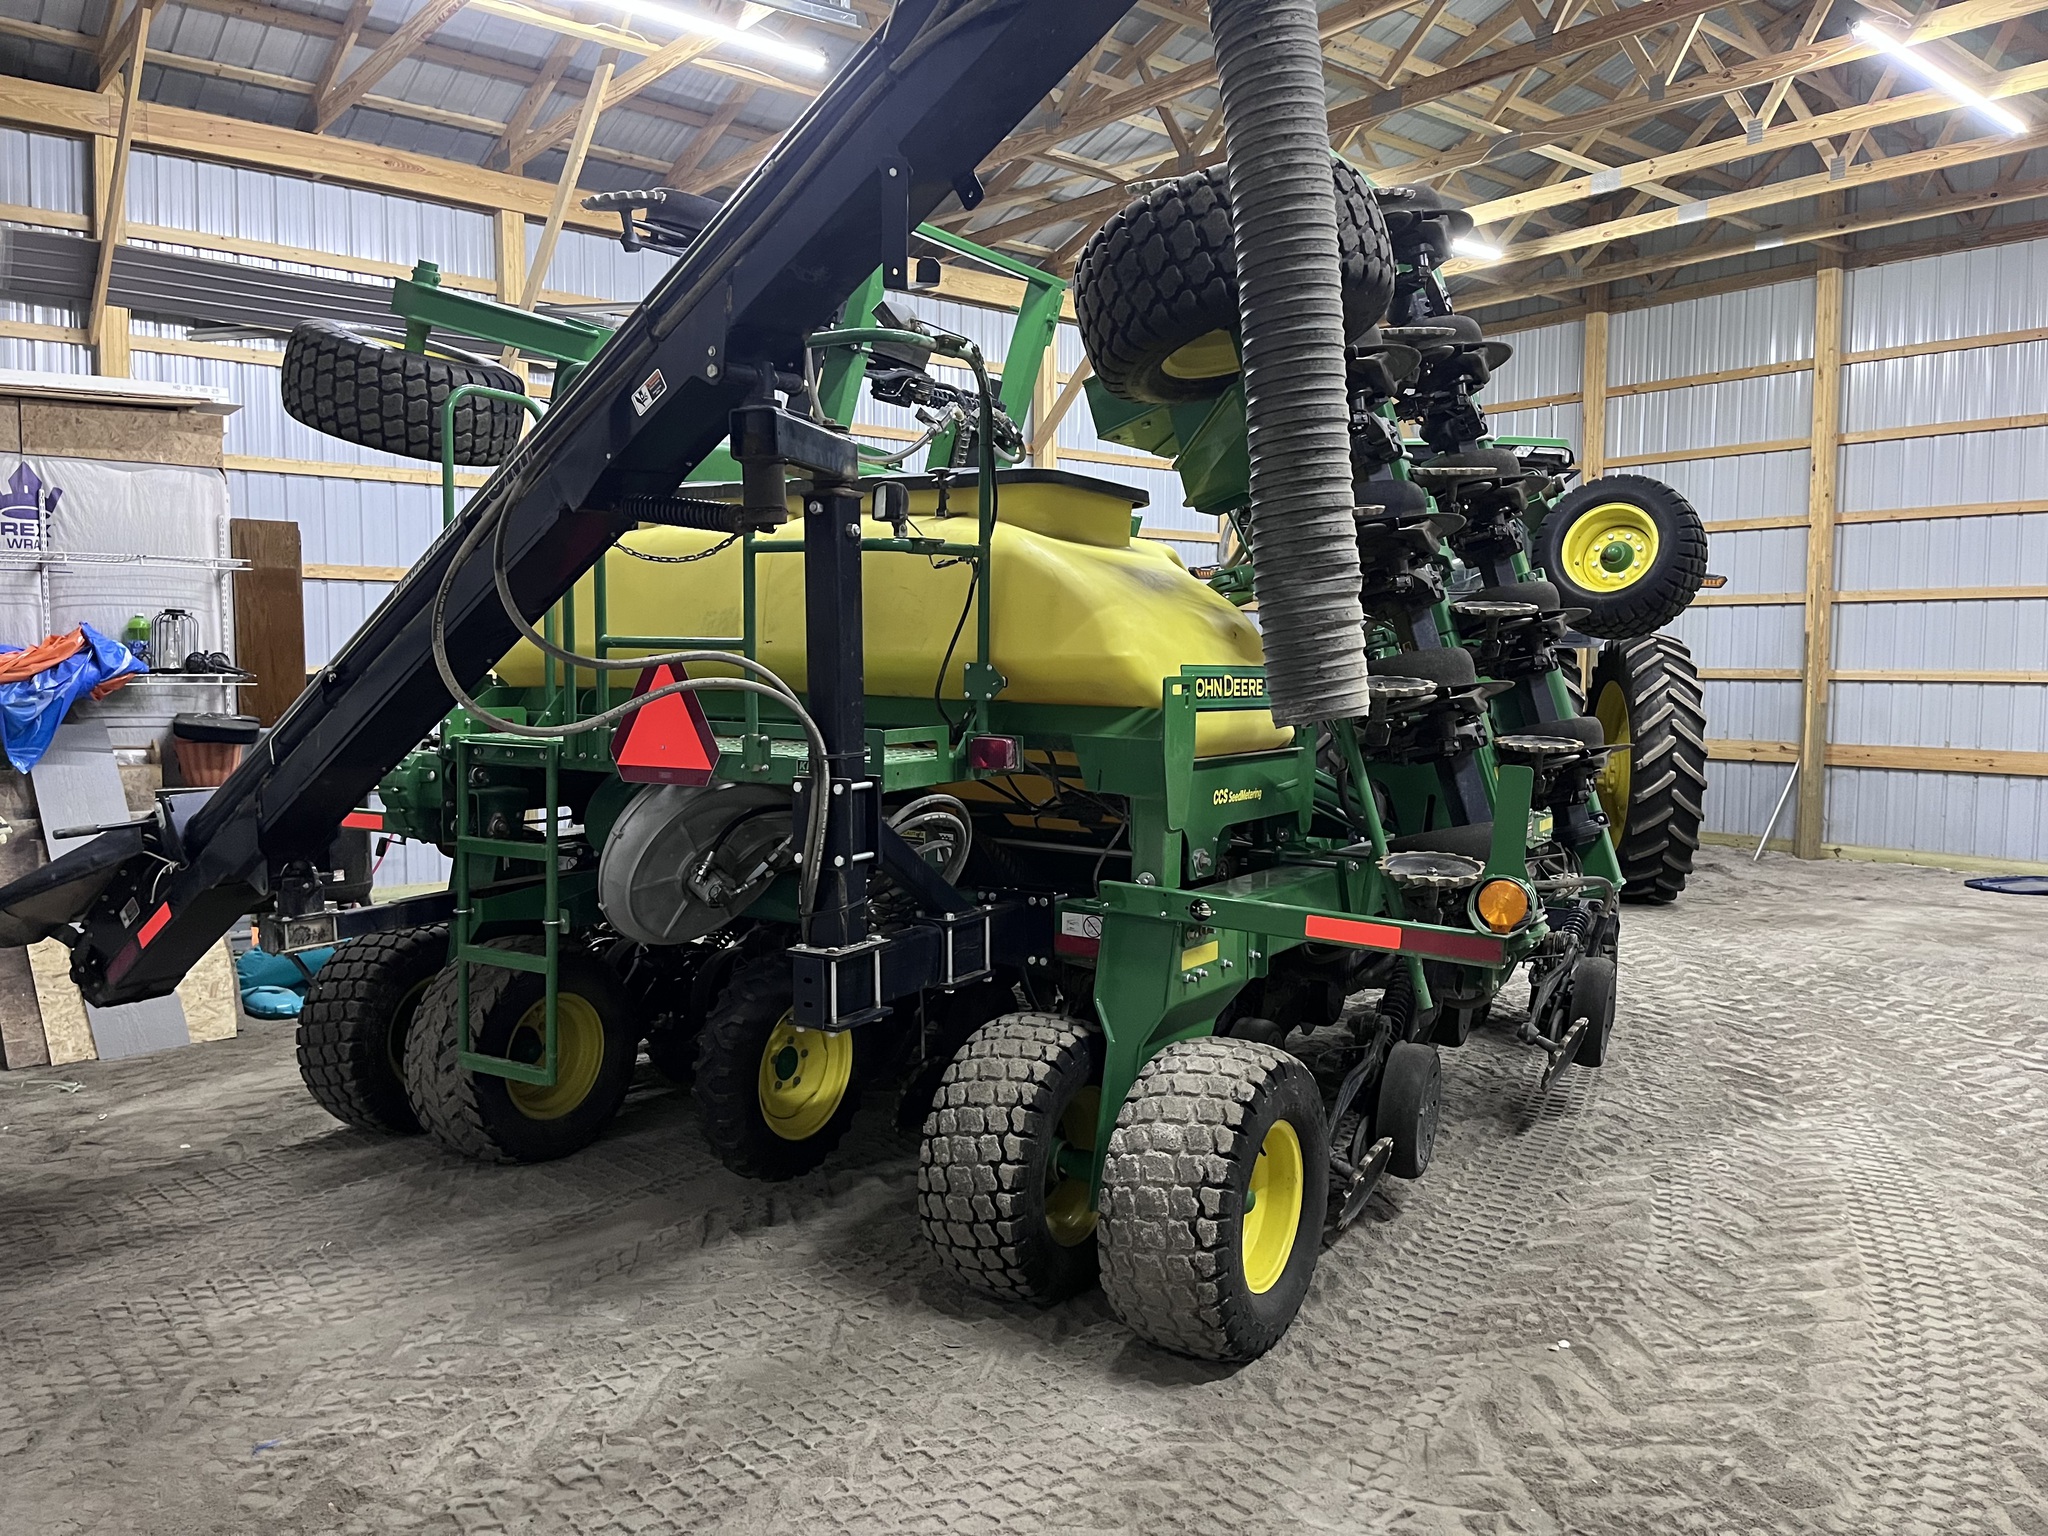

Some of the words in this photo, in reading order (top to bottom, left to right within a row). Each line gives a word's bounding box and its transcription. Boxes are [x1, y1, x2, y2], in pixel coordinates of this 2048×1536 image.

[0, 522, 52, 538] REX
[7, 538, 49, 549] WRA
[1195, 677, 1222, 698] OHN
[1223, 674, 1264, 698] DEERE
[1213, 788, 1229, 806] CCS
[1228, 787, 1263, 803] SeedMetering
